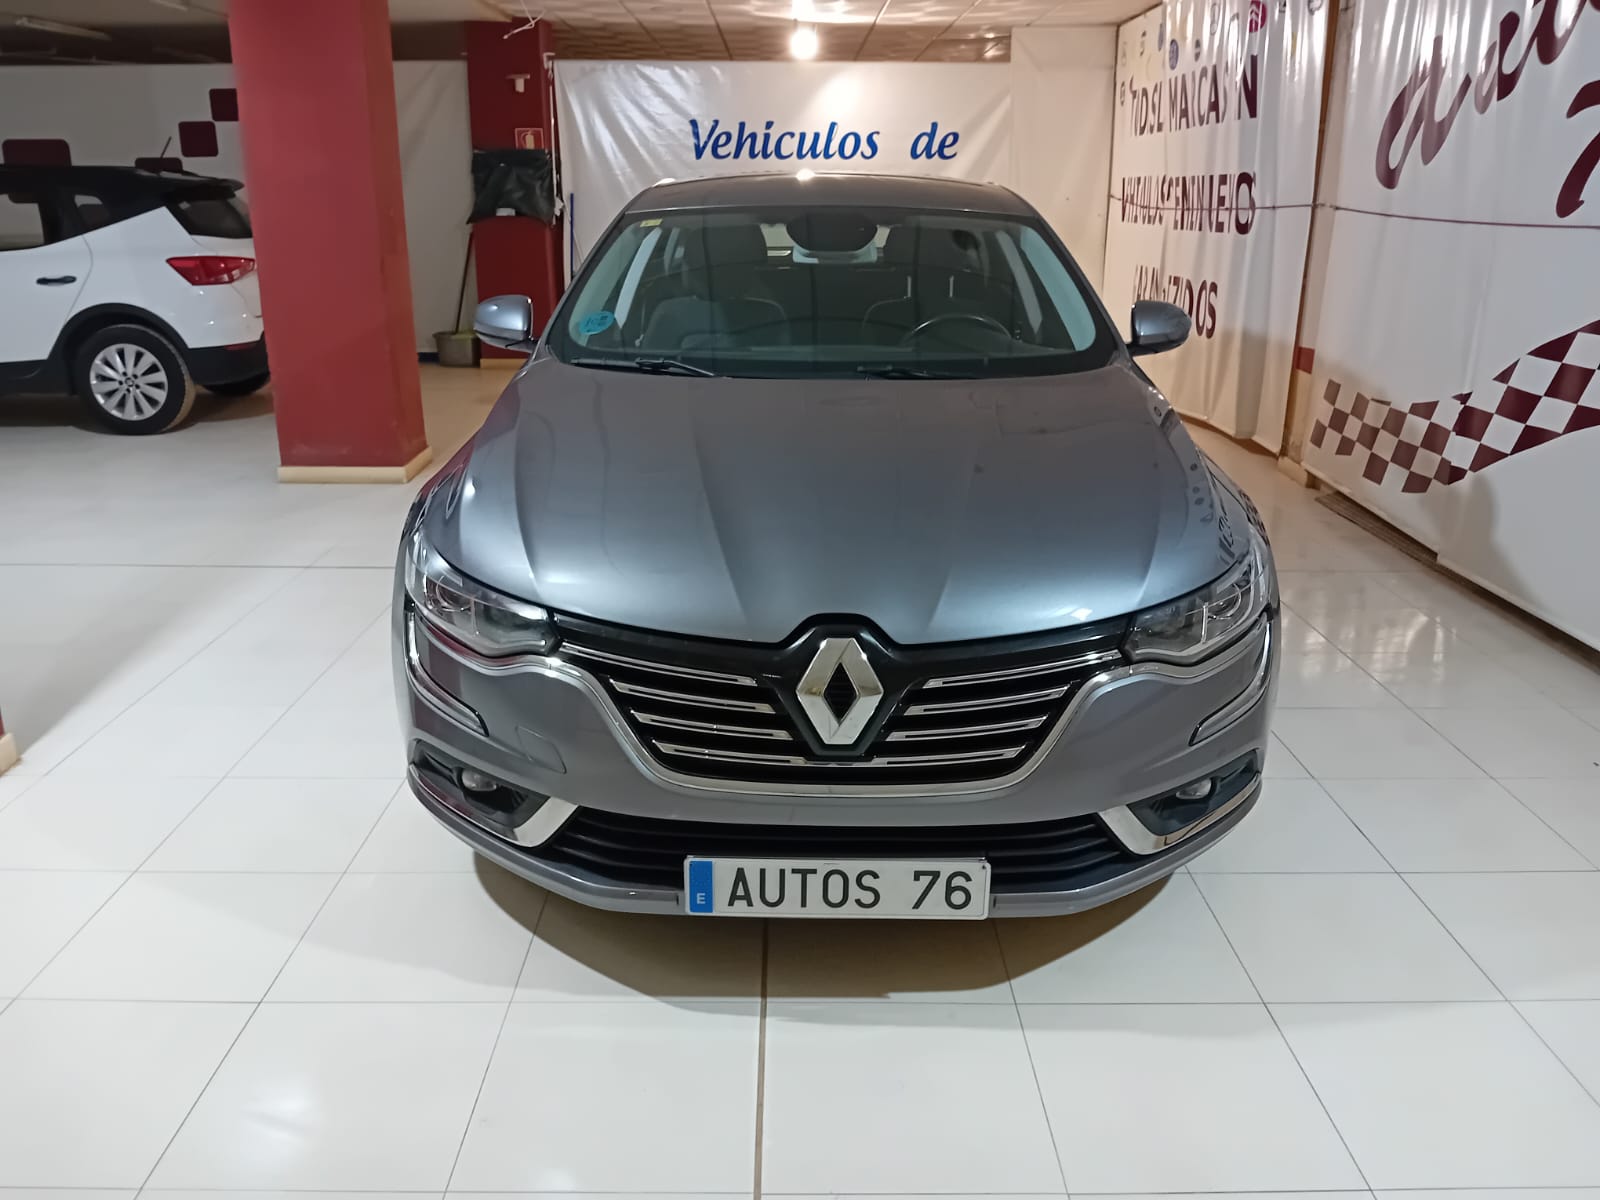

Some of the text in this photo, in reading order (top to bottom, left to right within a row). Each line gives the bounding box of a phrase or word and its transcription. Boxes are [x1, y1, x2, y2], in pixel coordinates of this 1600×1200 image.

[910, 121, 960, 161] de
[696, 892, 706, 905] E
[727, 867, 973, 911] AUTOS 76
